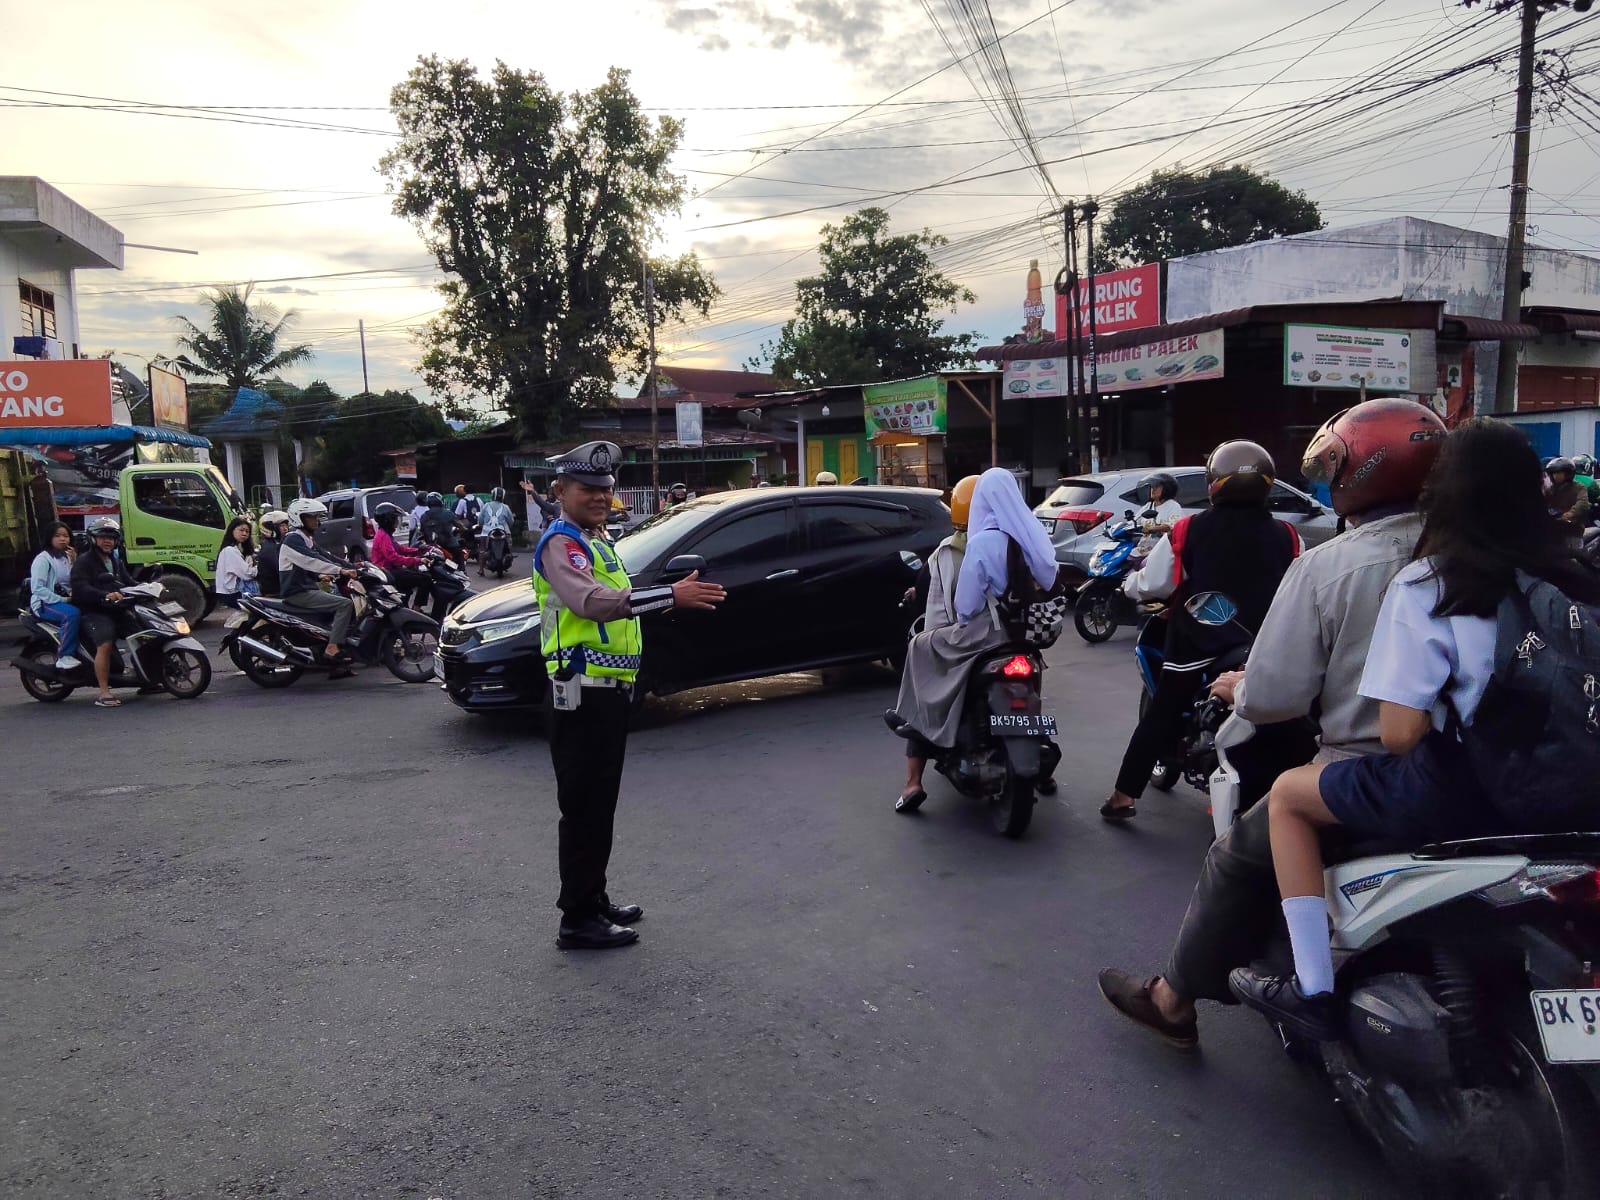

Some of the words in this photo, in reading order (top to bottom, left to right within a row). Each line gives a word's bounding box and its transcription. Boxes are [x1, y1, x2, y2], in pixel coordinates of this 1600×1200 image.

[1149, 335, 1199, 359] PALEK
[0, 395, 64, 418] ANG
[1034, 715, 1055, 726] TBP
[1539, 996, 1575, 1025] BK
[1579, 996, 1600, 1024] 6
